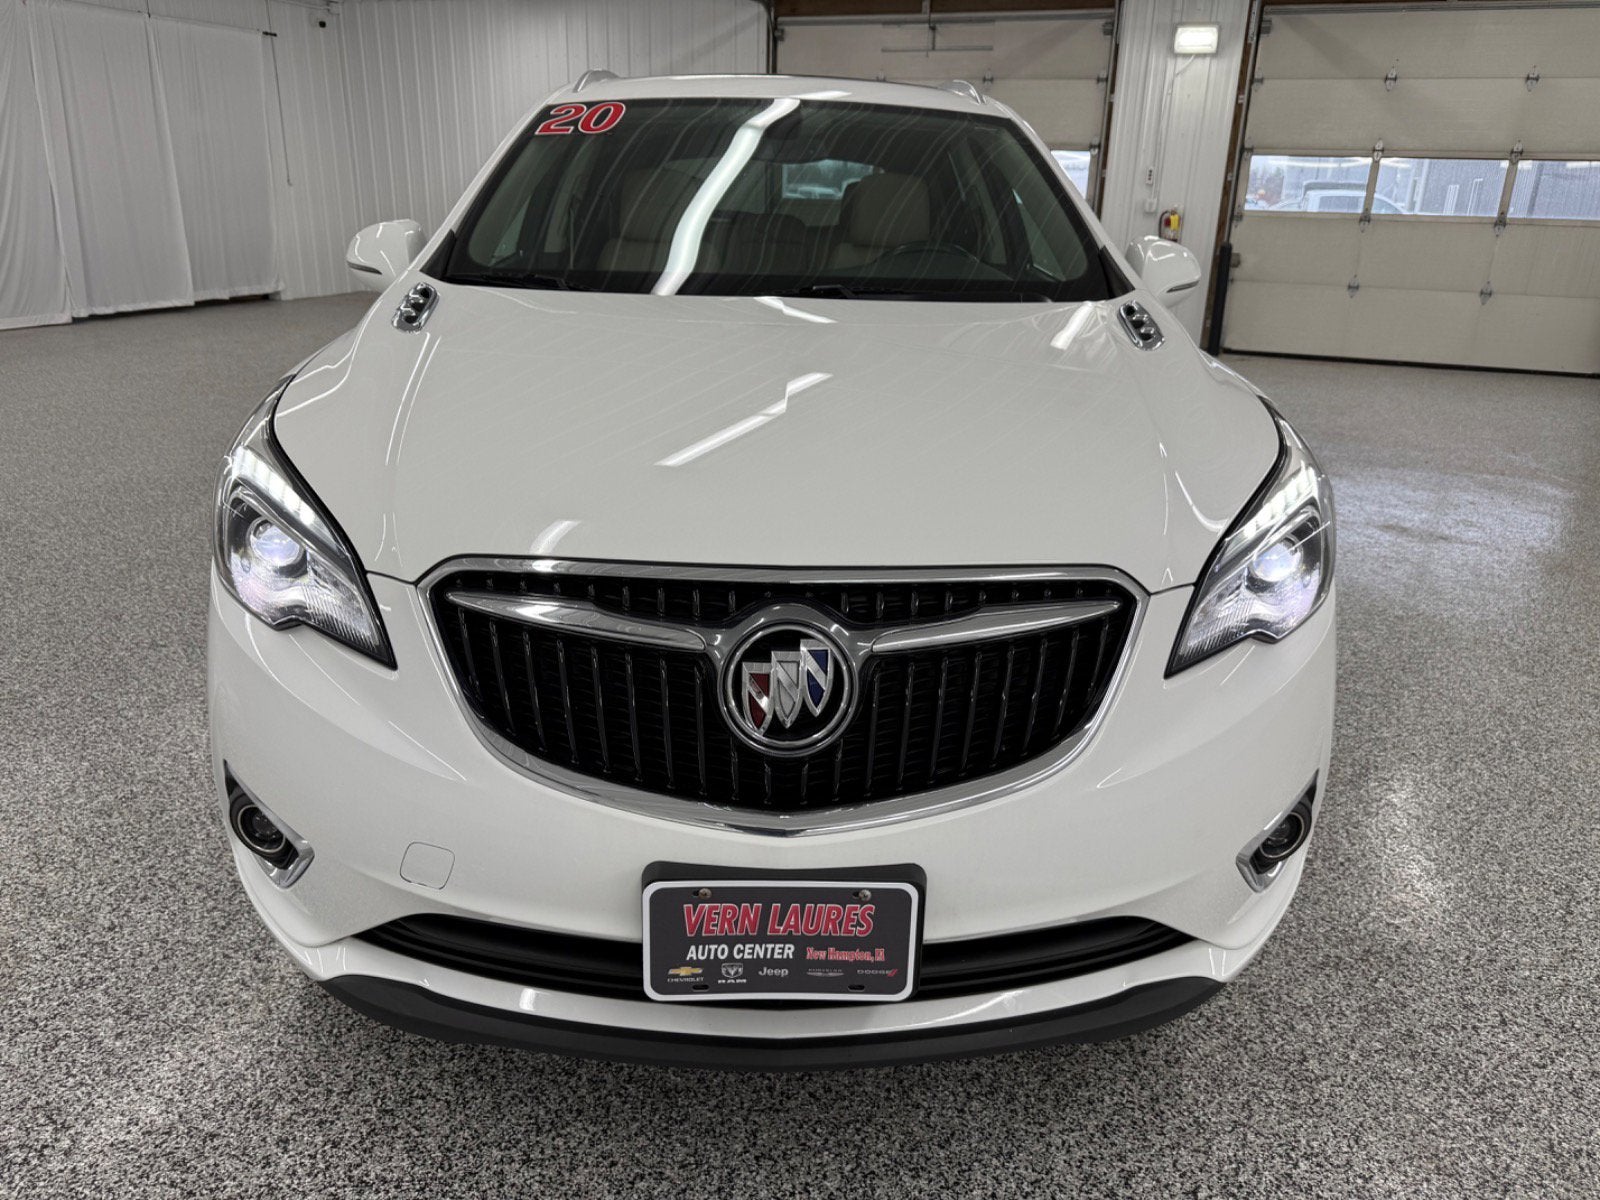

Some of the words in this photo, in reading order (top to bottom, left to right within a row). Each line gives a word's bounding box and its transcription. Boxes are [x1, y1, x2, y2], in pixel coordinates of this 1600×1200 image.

[535, 102, 626, 135] 20
[683, 903, 762, 937] VERN
[767, 903, 875, 937] LAURES
[686, 944, 729, 960] AUTO
[733, 943, 795, 959] CENTER
[806, 946, 827, 961] New
[758, 966, 789, 978] Jeep
